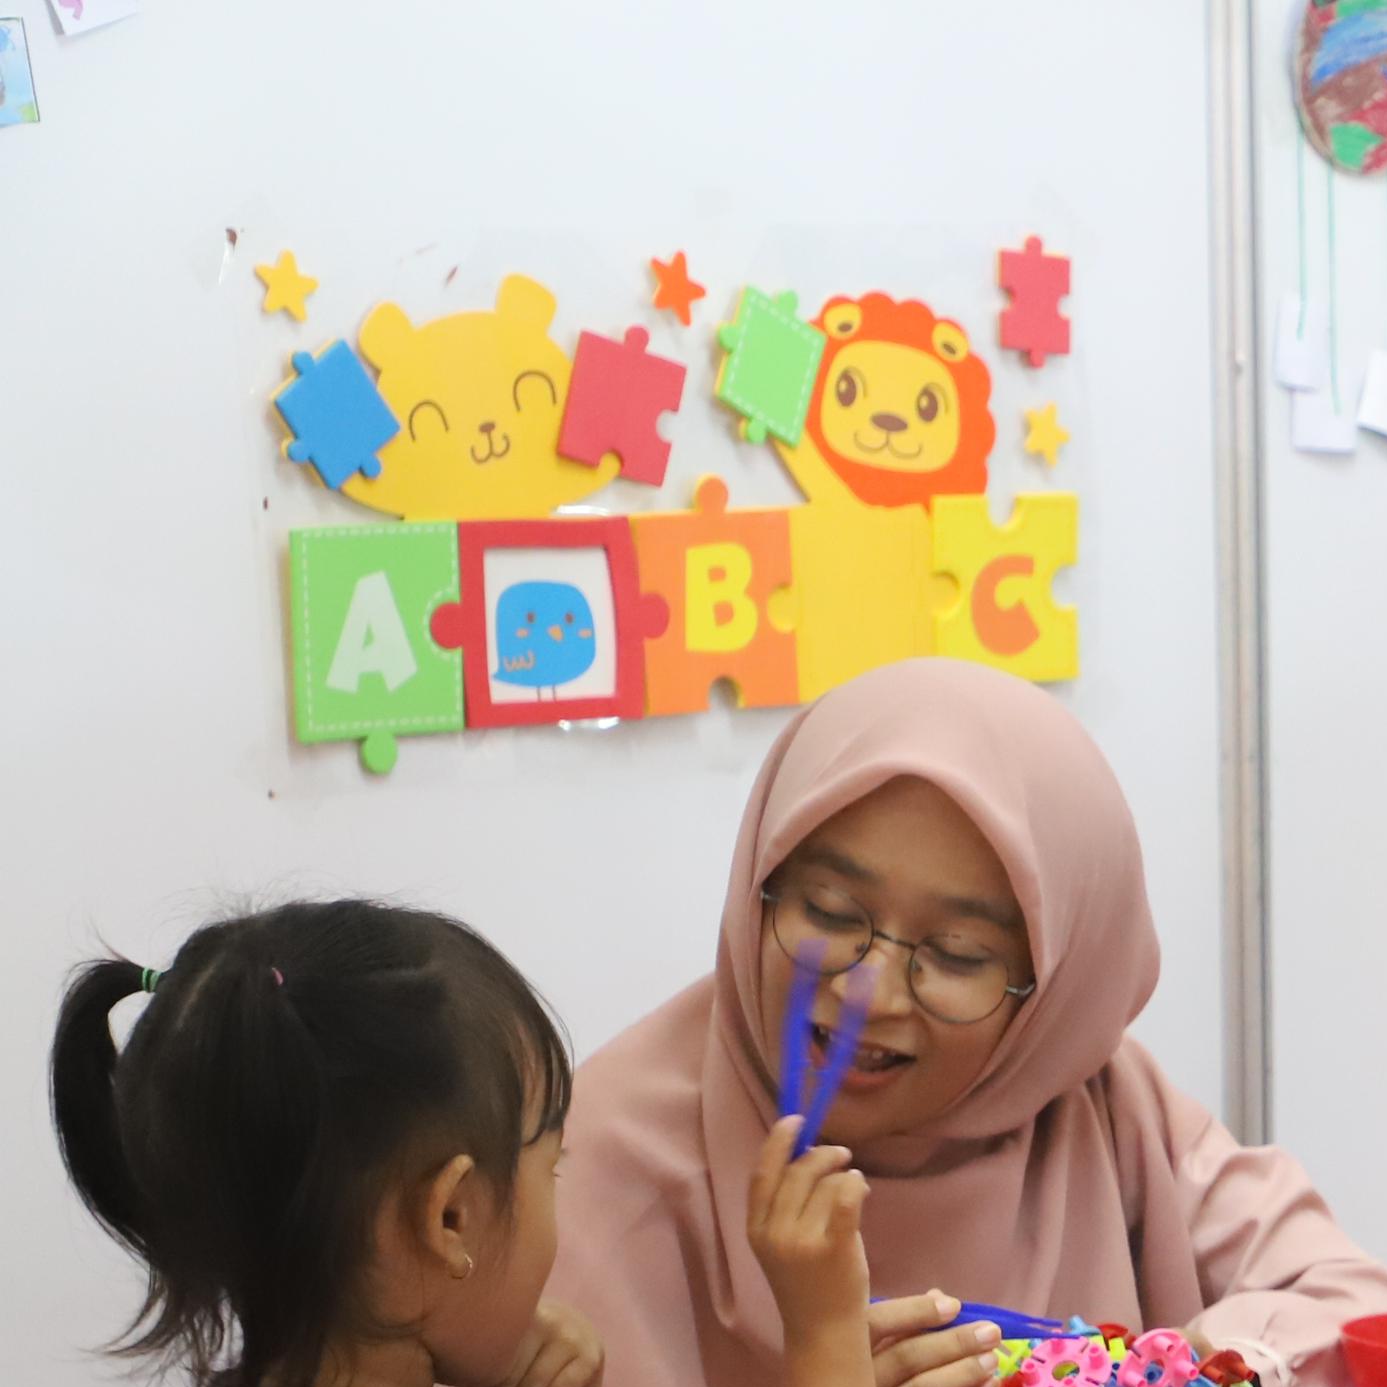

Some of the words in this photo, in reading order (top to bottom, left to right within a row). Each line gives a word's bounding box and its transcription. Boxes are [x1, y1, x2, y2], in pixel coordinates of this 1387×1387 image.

[327, 570, 418, 693] A
[685, 541, 758, 652] B
[970, 554, 1040, 657] C
